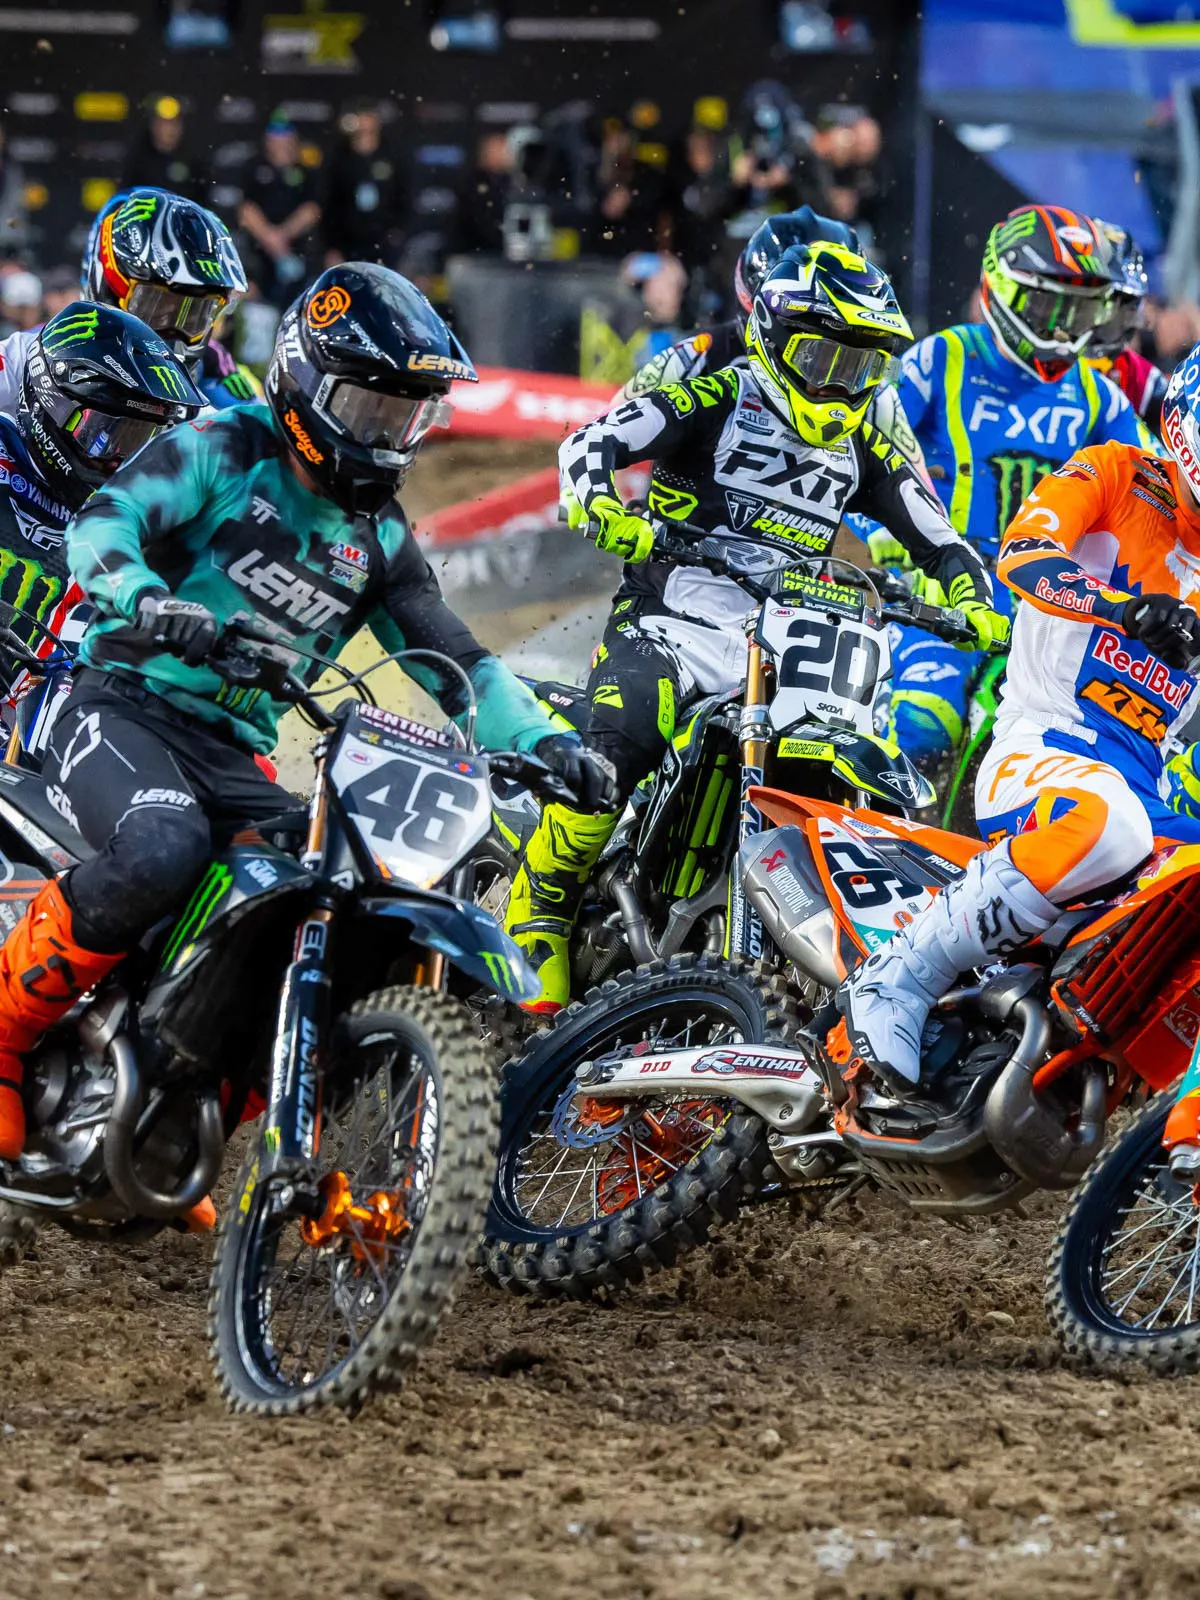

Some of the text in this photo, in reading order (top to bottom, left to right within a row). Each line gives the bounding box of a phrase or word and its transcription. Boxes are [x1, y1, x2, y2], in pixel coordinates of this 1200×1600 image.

[969, 395, 1085, 447] FXR
[1165, 405, 1198, 470] Red
[719, 440, 854, 512] FXR
[1130, 487, 1177, 521] PROGRESSIVE
[751, 518, 830, 552] RACING
[761, 505, 834, 541] TRIUMPH
[762, 533, 795, 547] FACTORY
[329, 543, 368, 570] AMA
[227, 549, 351, 630] LEATT
[783, 579, 859, 607] RENTHAL
[1035, 577, 1096, 614] Red Bull
[779, 619, 880, 706] 20
[1092, 631, 1191, 711] Red Bull
[549, 693, 573, 706] GUTS
[1079, 677, 1169, 747] KTM
[360, 703, 451, 746] RENTHAL
[830, 733, 858, 746] FXR
[783, 741, 828, 756] PROGRESSIVE
[131, 788, 197, 805] LEATT
[340, 758, 479, 861] 46
[243, 859, 279, 888] KTM
[822, 842, 925, 909] 26
[925, 853, 962, 875] PRADO
[855, 1036, 875, 1063] FOX
[639, 1060, 672, 1074] DID
